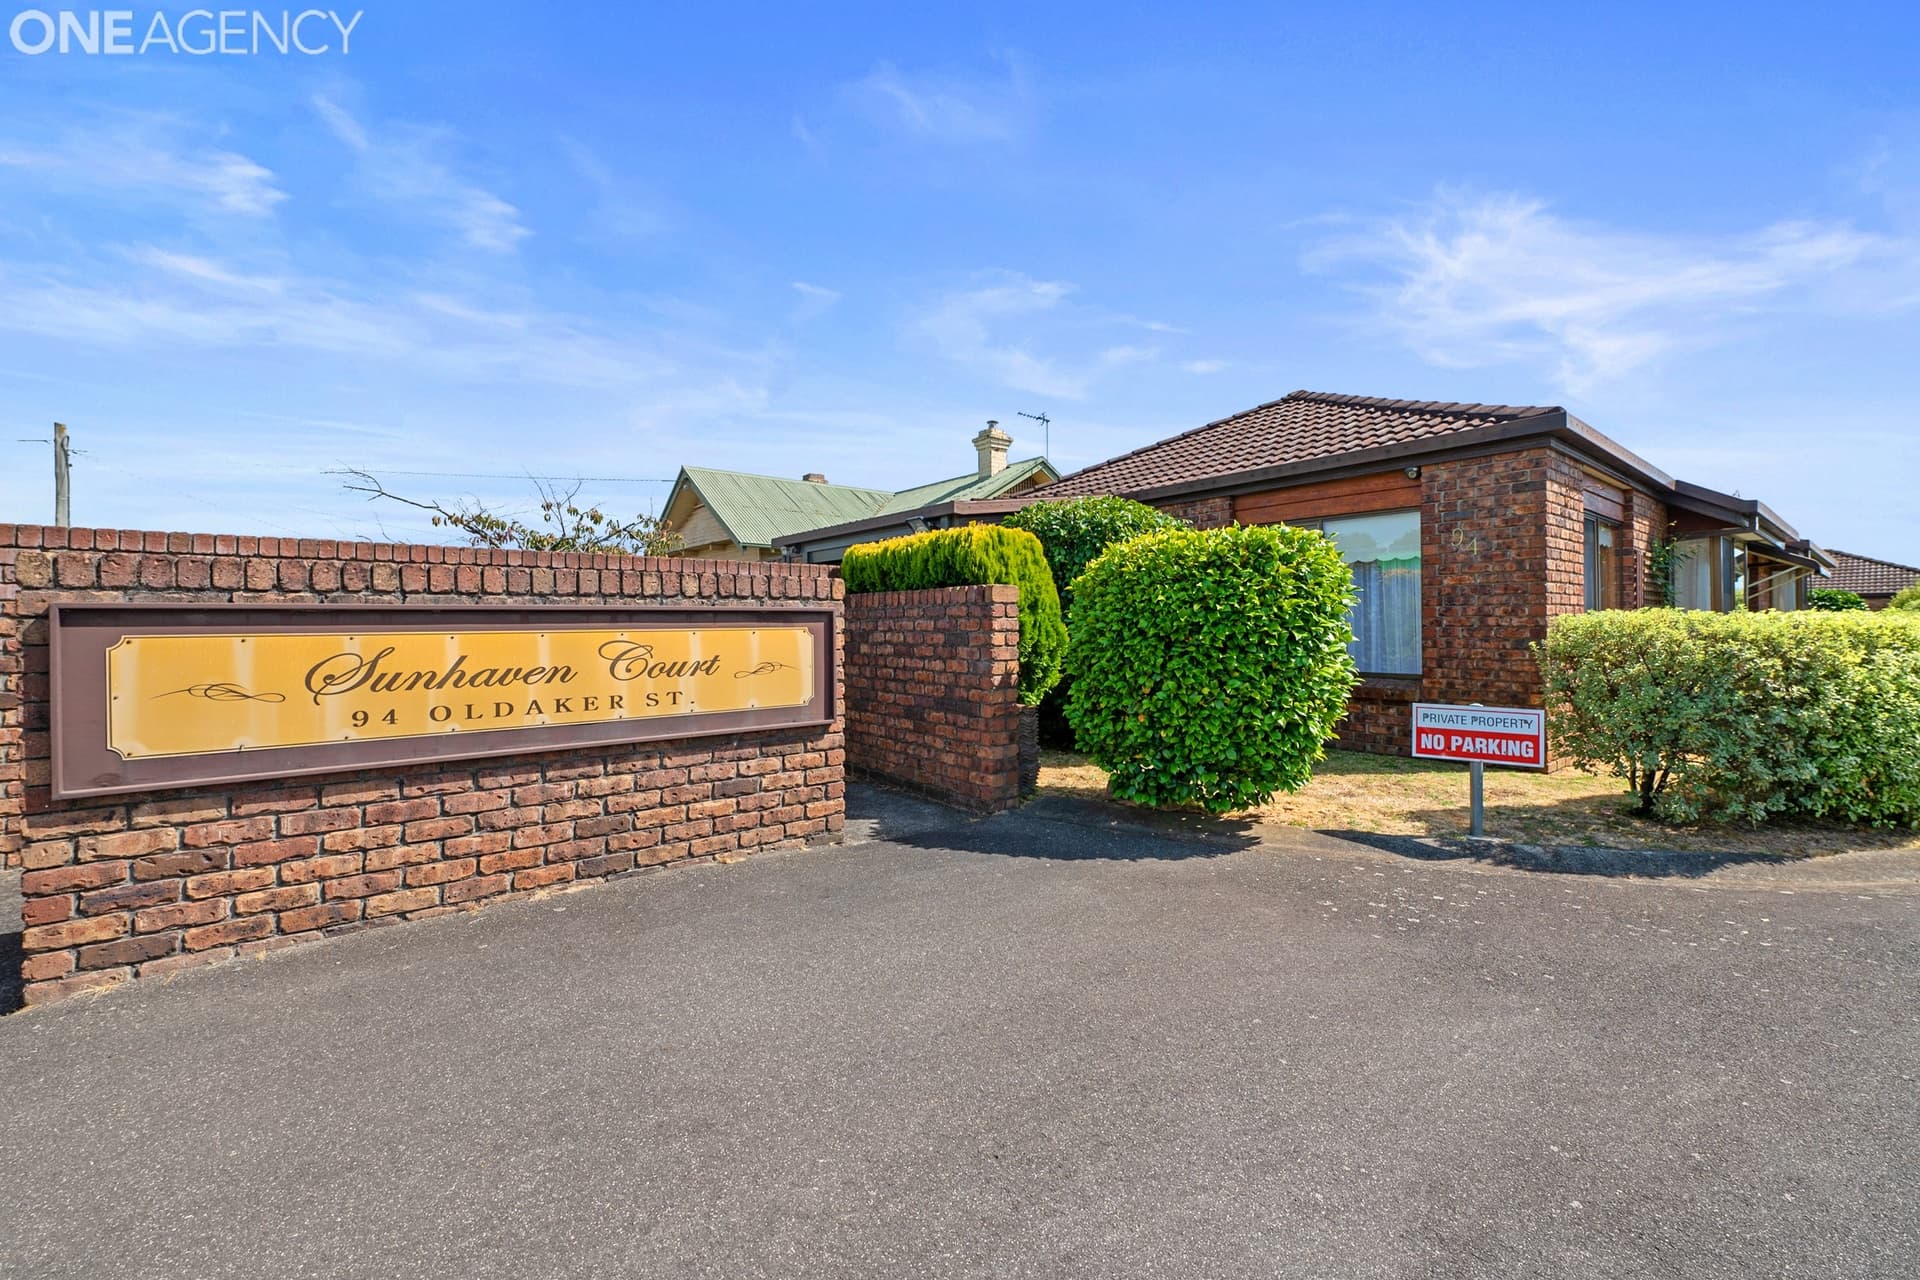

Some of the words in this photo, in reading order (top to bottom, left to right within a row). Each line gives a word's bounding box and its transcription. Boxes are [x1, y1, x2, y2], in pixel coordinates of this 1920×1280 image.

[304, 646, 578, 706] Sunhaven
[598, 639, 721, 682] Court
[351, 708, 400, 728] 94
[428, 693, 624, 723] OLDAKER
[1422, 712, 1467, 726] PRIVATE
[1470, 715, 1534, 729] PROPERTY
[1420, 733, 1445, 751] NO
[1450, 735, 1535, 758] PARKING
